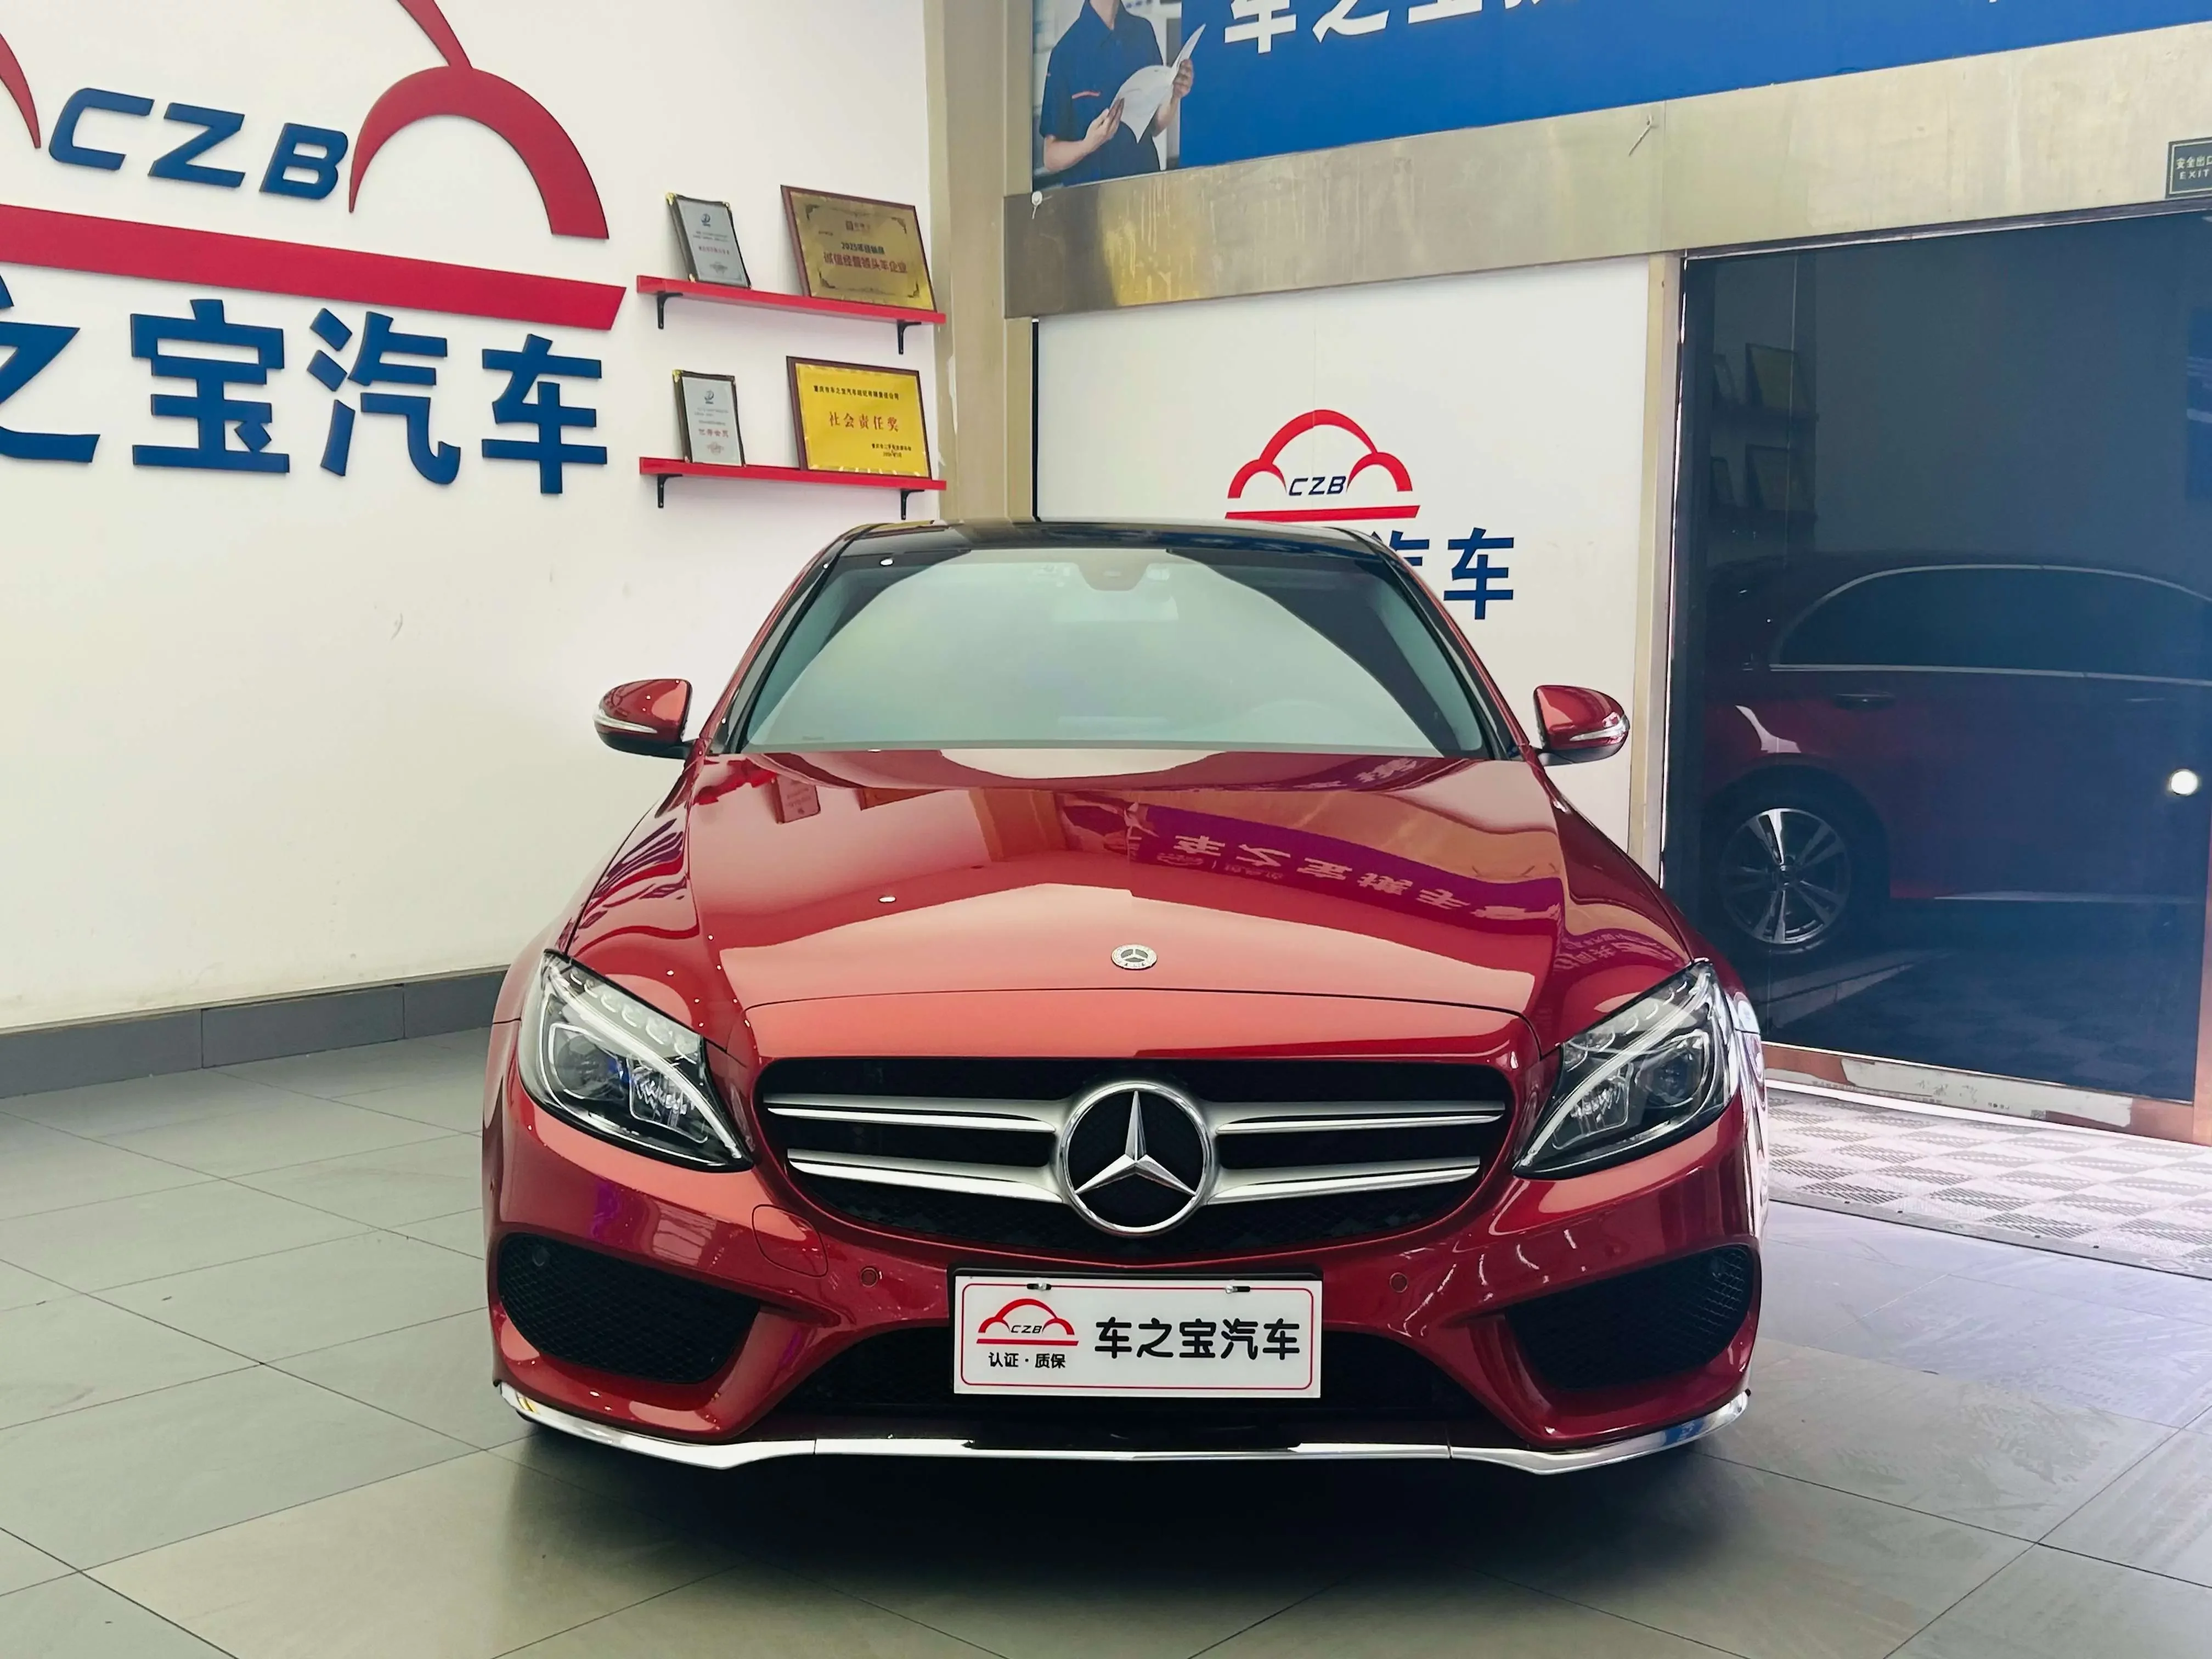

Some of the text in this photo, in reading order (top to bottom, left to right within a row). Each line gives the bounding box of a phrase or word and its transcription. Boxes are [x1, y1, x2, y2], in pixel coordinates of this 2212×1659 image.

[48, 87, 349, 200] CZB
[2179, 168, 2209, 180] EXIT
[828, 411, 899, 432] 社会责任奖
[1288, 476, 1347, 496] CZB
[1011, 1324, 1042, 1334] CZB
[1094, 1317, 1301, 1361] 车之宝汽车
